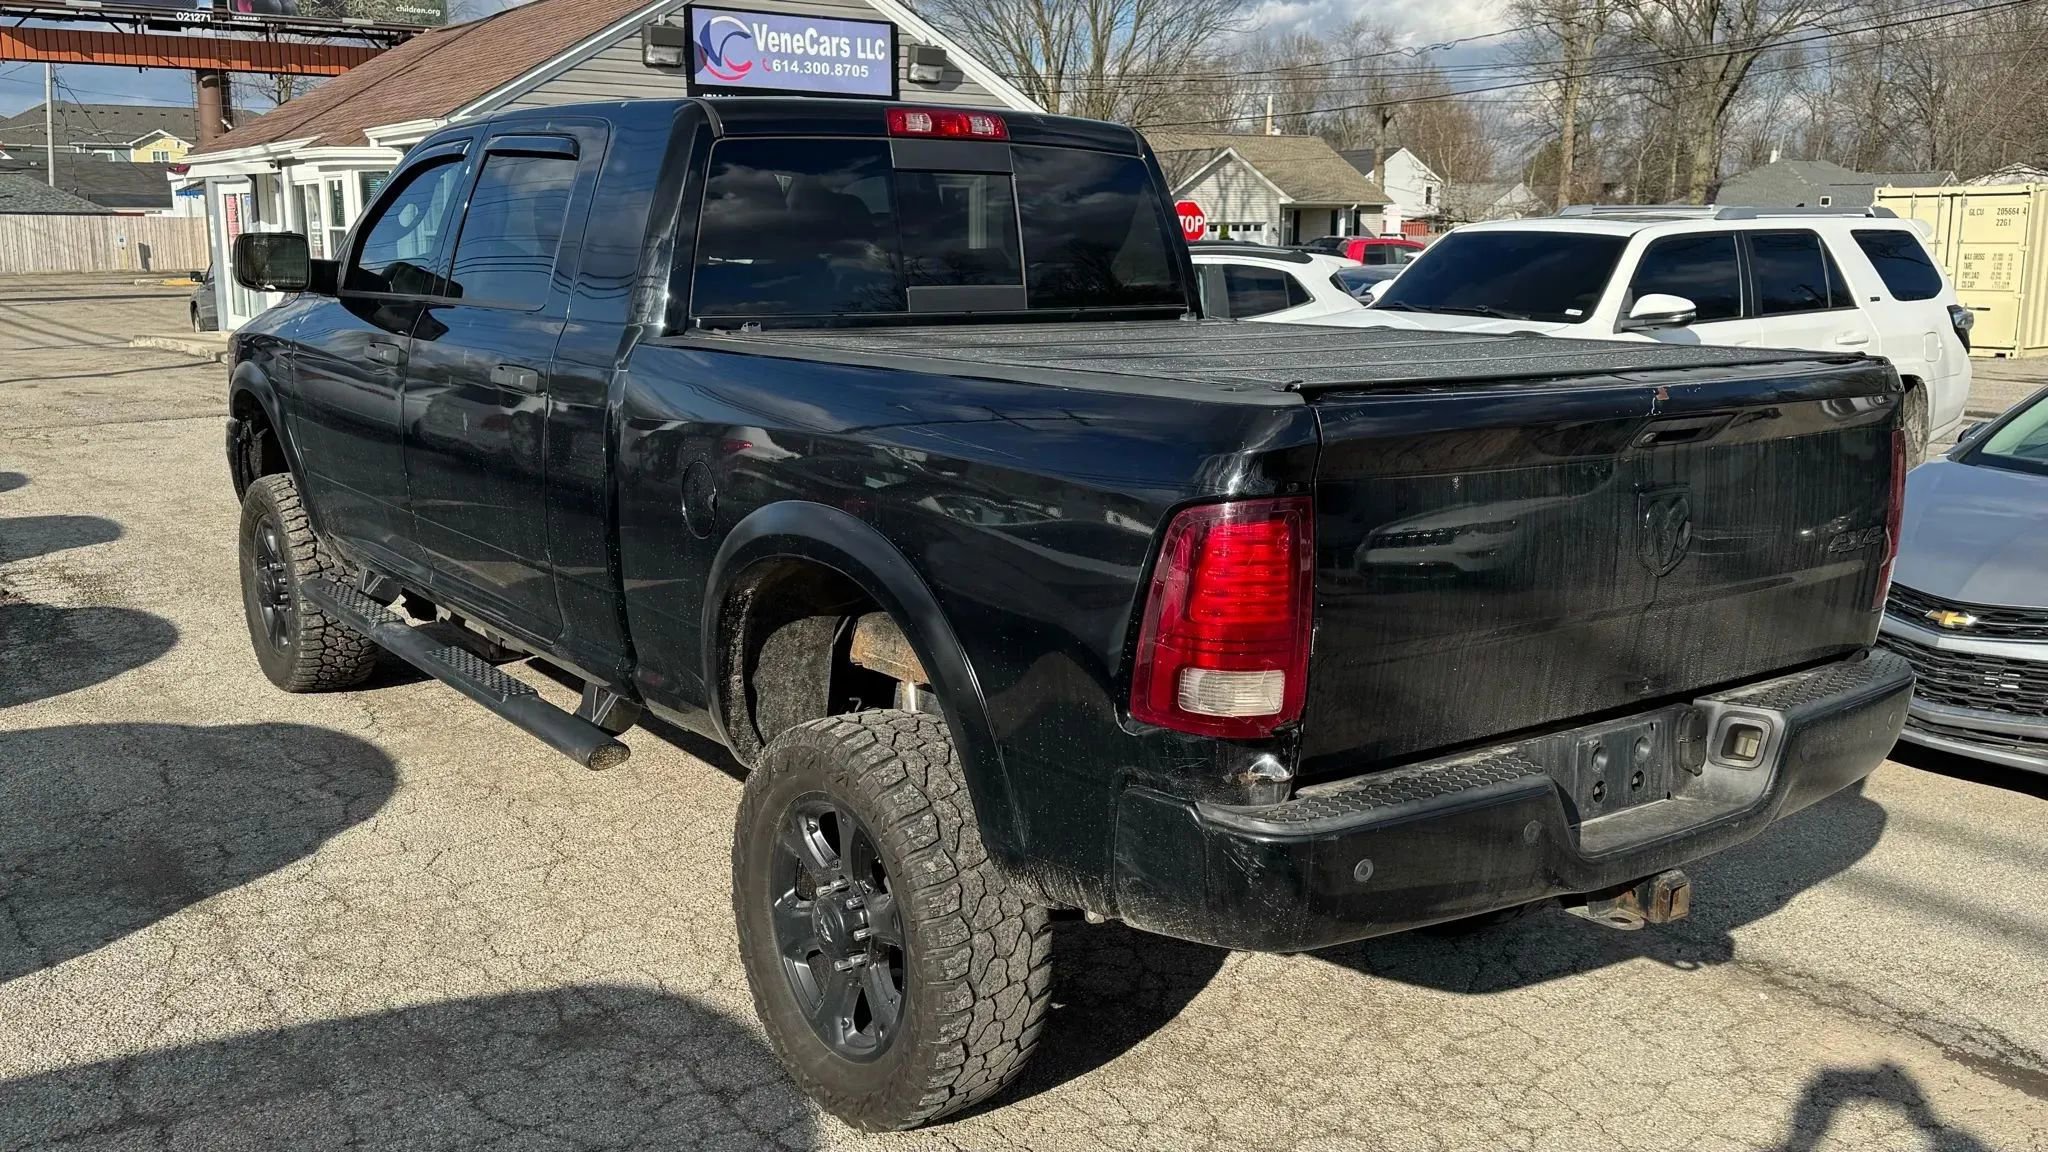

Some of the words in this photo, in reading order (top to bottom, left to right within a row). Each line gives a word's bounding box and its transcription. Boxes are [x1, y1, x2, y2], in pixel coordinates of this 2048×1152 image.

[176, 12, 211, 22] 021271
[395, 4, 441, 17] children.org
[752, 23, 851, 58] VeneCars
[856, 37, 886, 61] LLC
[772, 59, 869, 78] 614.300.8705
[1179, 215, 1204, 233] TOP
